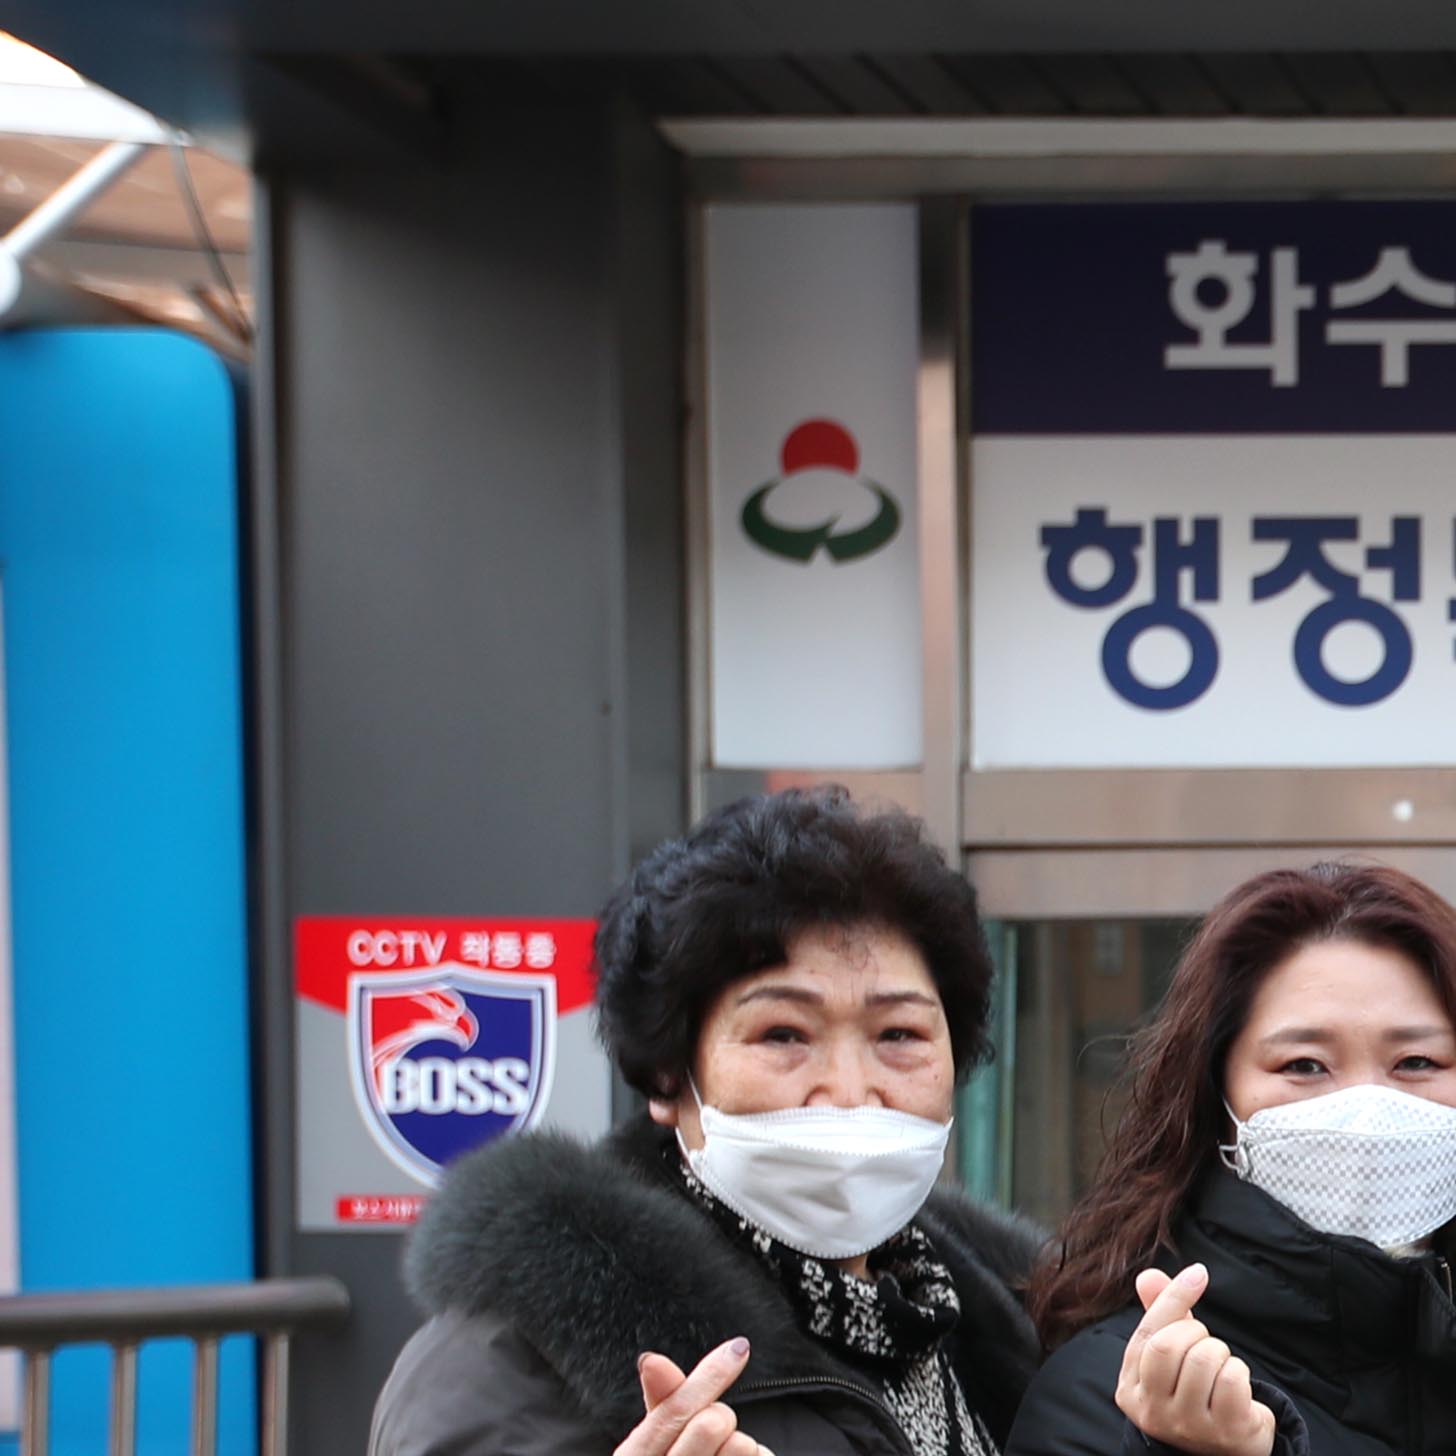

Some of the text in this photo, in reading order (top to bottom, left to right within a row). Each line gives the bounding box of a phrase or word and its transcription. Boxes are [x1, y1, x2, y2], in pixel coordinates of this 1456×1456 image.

[348, 931, 556, 968] CCTV 작동중
[382, 1056, 532, 1115] BOSS
